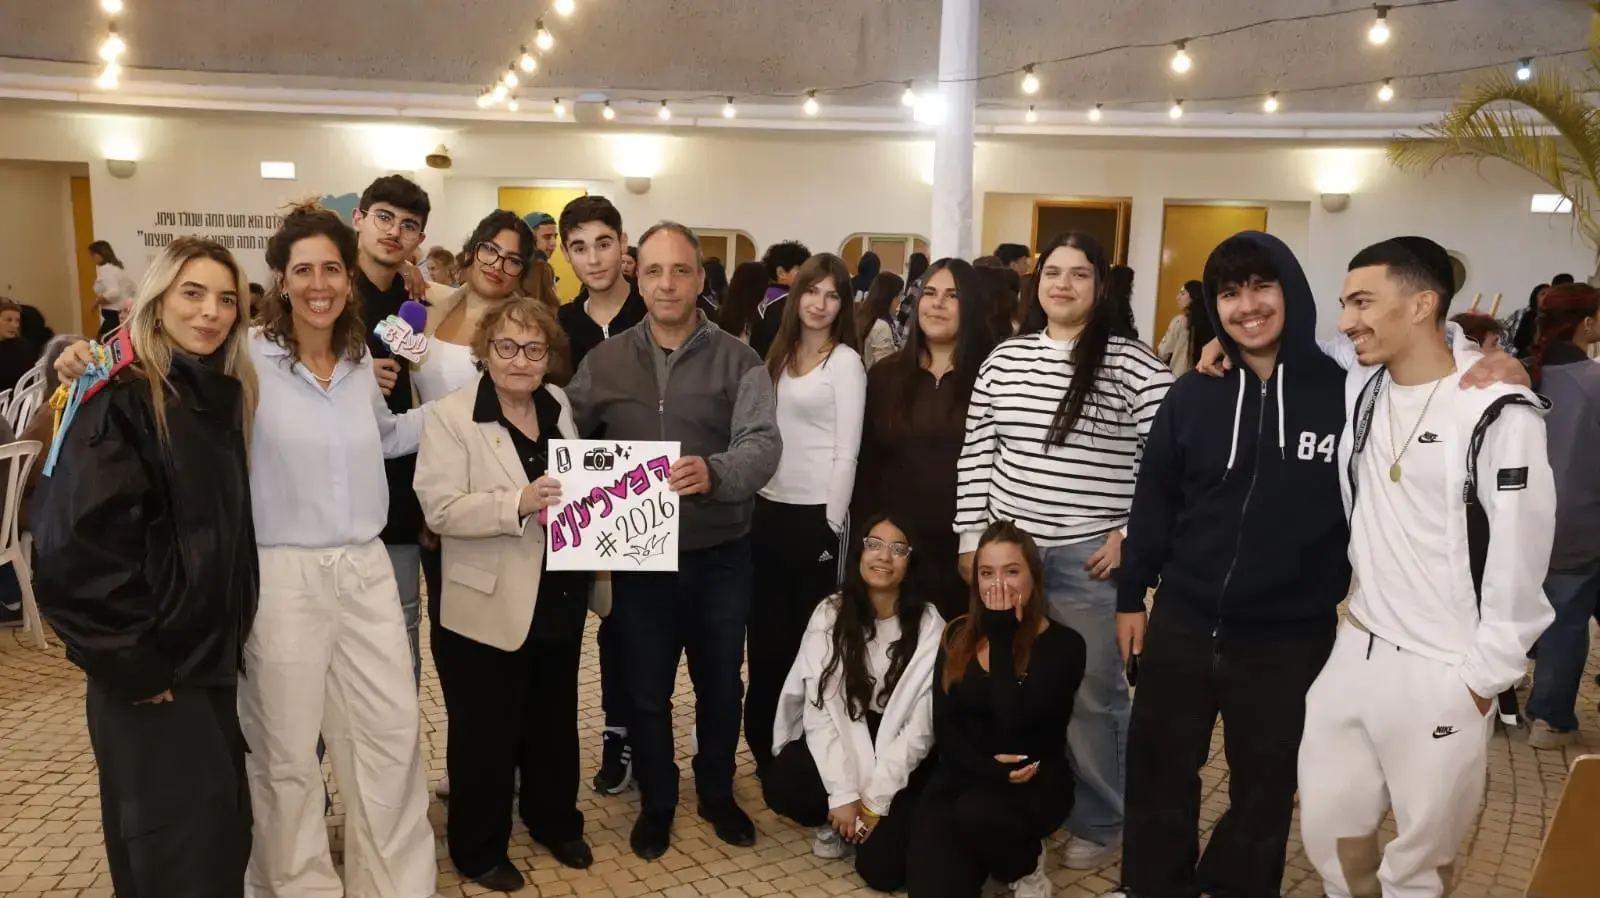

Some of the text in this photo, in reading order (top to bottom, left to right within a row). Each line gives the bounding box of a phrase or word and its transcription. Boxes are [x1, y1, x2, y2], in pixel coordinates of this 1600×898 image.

[155, 211, 176, 226] עימו,
[177, 212, 203, 227] שנולד
[205, 213, 225, 228] ממה
[226, 214, 246, 228] מעט
[248, 215, 263, 229] הוא
[237, 235, 256, 249] ממה
[1297, 431, 1335, 463] 84
[595, 491, 675, 557] #2026
